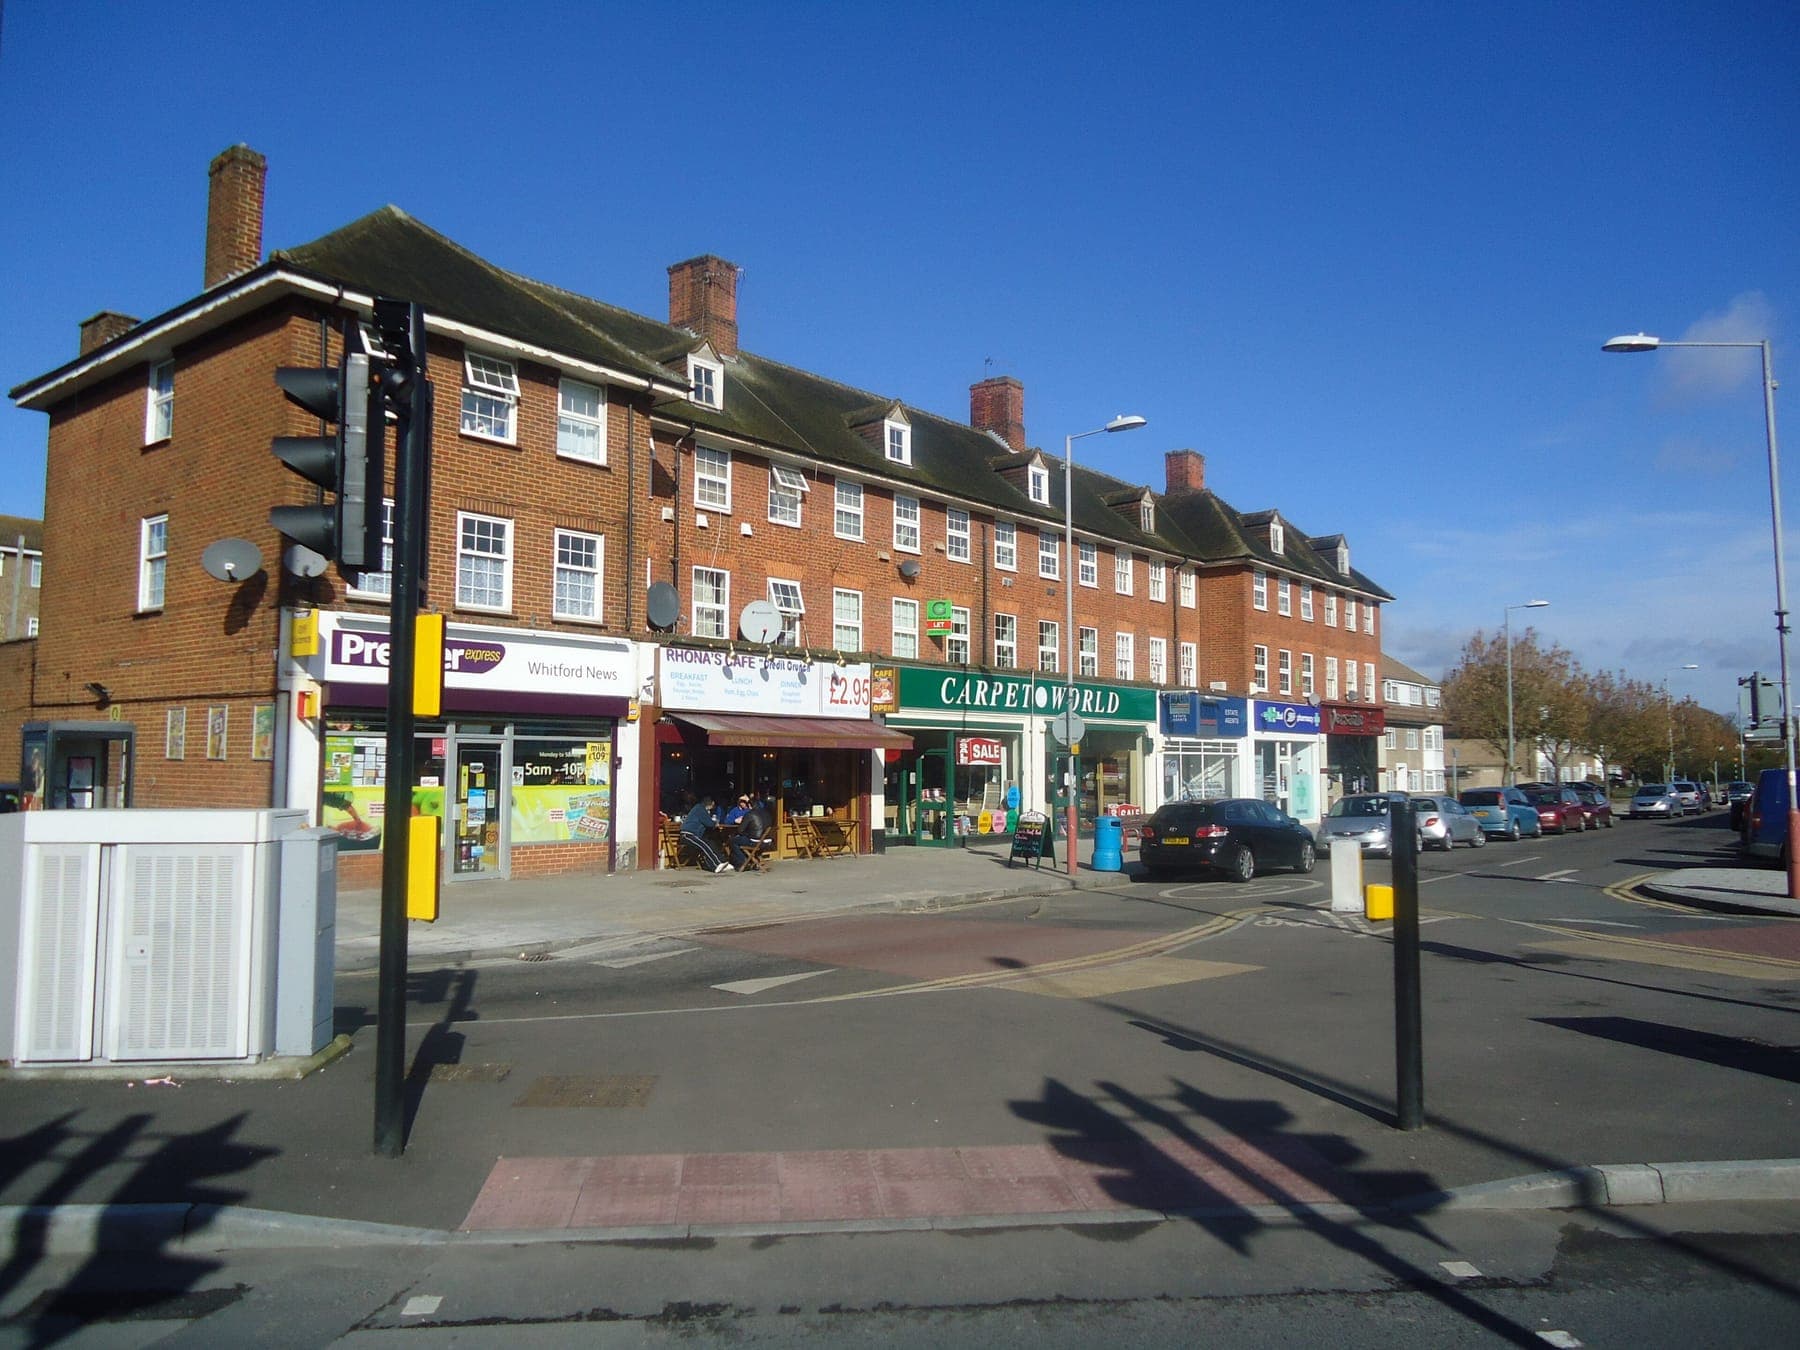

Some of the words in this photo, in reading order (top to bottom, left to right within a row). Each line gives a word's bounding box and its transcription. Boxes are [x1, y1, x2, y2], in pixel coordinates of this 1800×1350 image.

[464, 648, 501, 663] express
[666, 648, 722, 666] RHONA'S
[528, 661, 582, 678] Whitford
[586, 666, 618, 681] News
[670, 671, 709, 681] BREAKFAST
[874, 669, 893, 677] CAFE
[829, 676, 870, 706] £2.95
[940, 677, 1033, 708] CARPET
[1051, 685, 1120, 714] WORLD
[873, 704, 893, 712] OPEN
[590, 744, 606, 752] milk
[959, 738, 968, 764] SALE
[973, 744, 1000, 759] SALE
[525, 762, 552, 776] 5am
[562, 762, 586, 778] 10p
